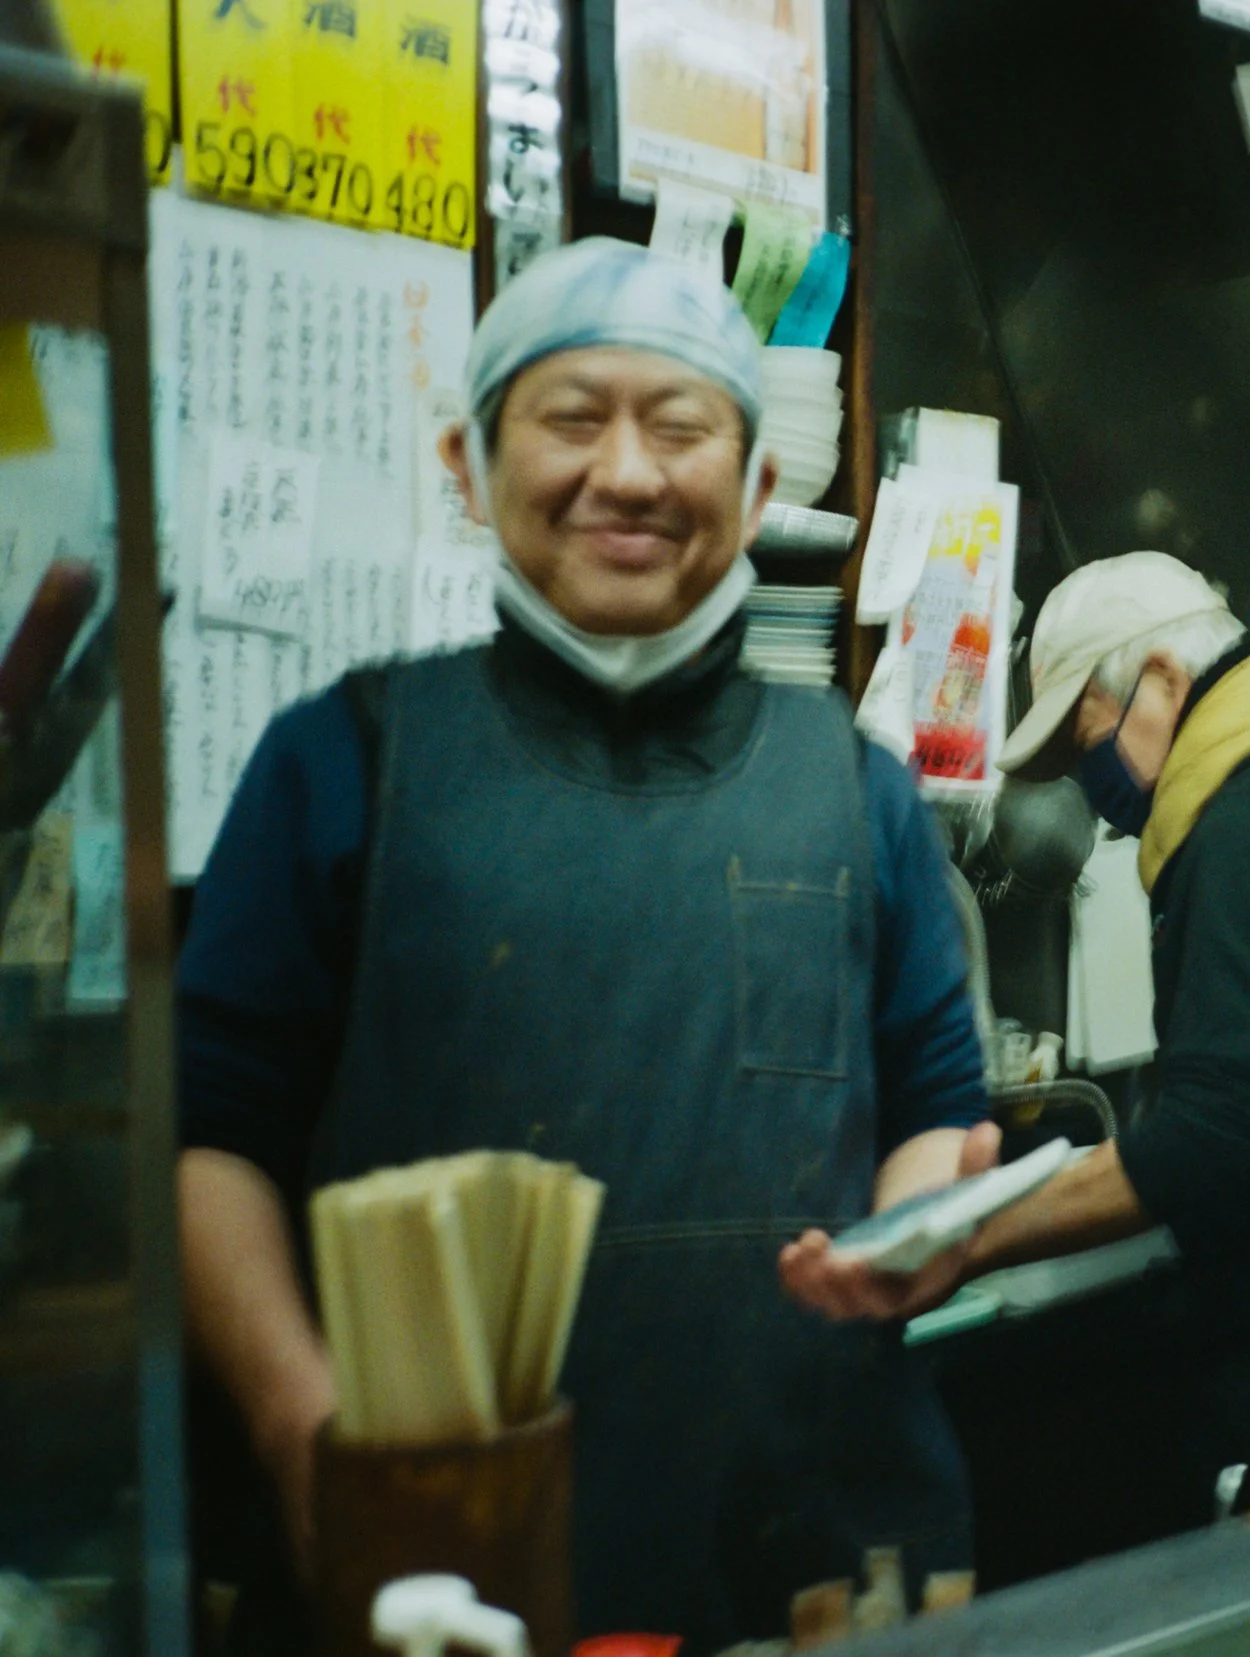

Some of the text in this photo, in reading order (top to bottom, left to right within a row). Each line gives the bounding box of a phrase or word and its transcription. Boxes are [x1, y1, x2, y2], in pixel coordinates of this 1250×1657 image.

[400, 13, 450, 67] 酒
[194, 118, 296, 196] 590
[297, 147, 374, 216] 370
[385, 172, 470, 241] 480
